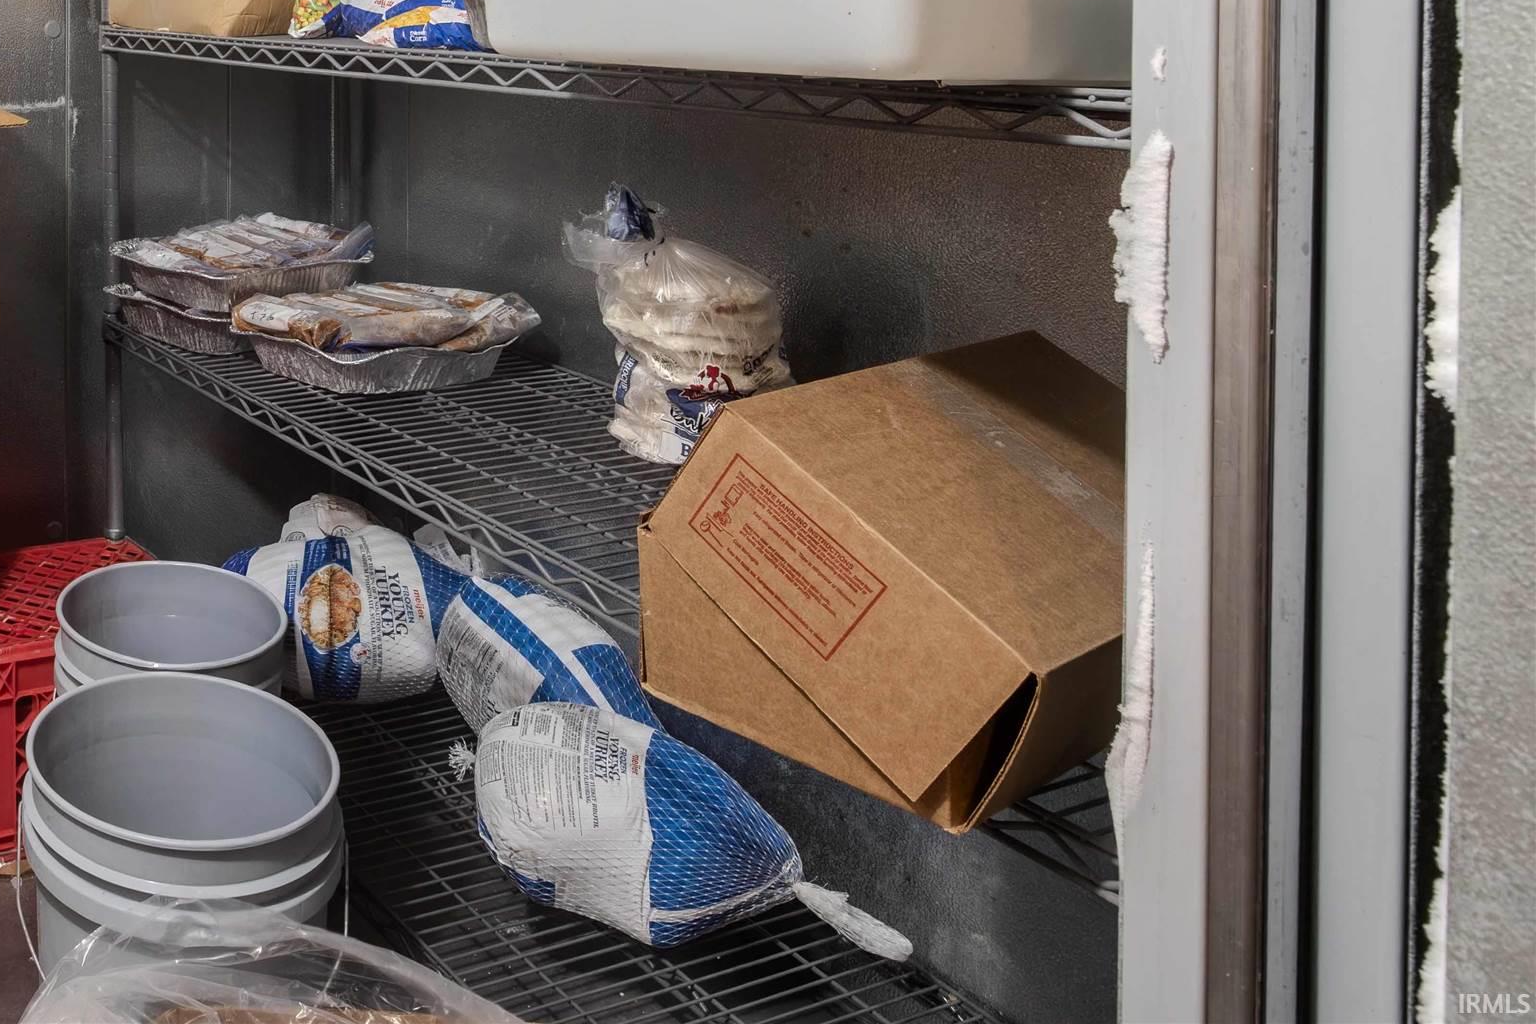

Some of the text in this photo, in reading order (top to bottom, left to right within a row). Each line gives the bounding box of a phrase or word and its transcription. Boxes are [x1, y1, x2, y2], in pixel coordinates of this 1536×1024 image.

[774, 498, 808, 528] HANDLING
[807, 524, 854, 570] INSTRUCTIONS
[375, 566, 395, 640] TURKEY
[388, 572, 408, 635] YOUNG
[403, 585, 415, 623] FROZEN
[413, 589, 424, 619] meijer
[595, 730, 609, 783] TURKEY
